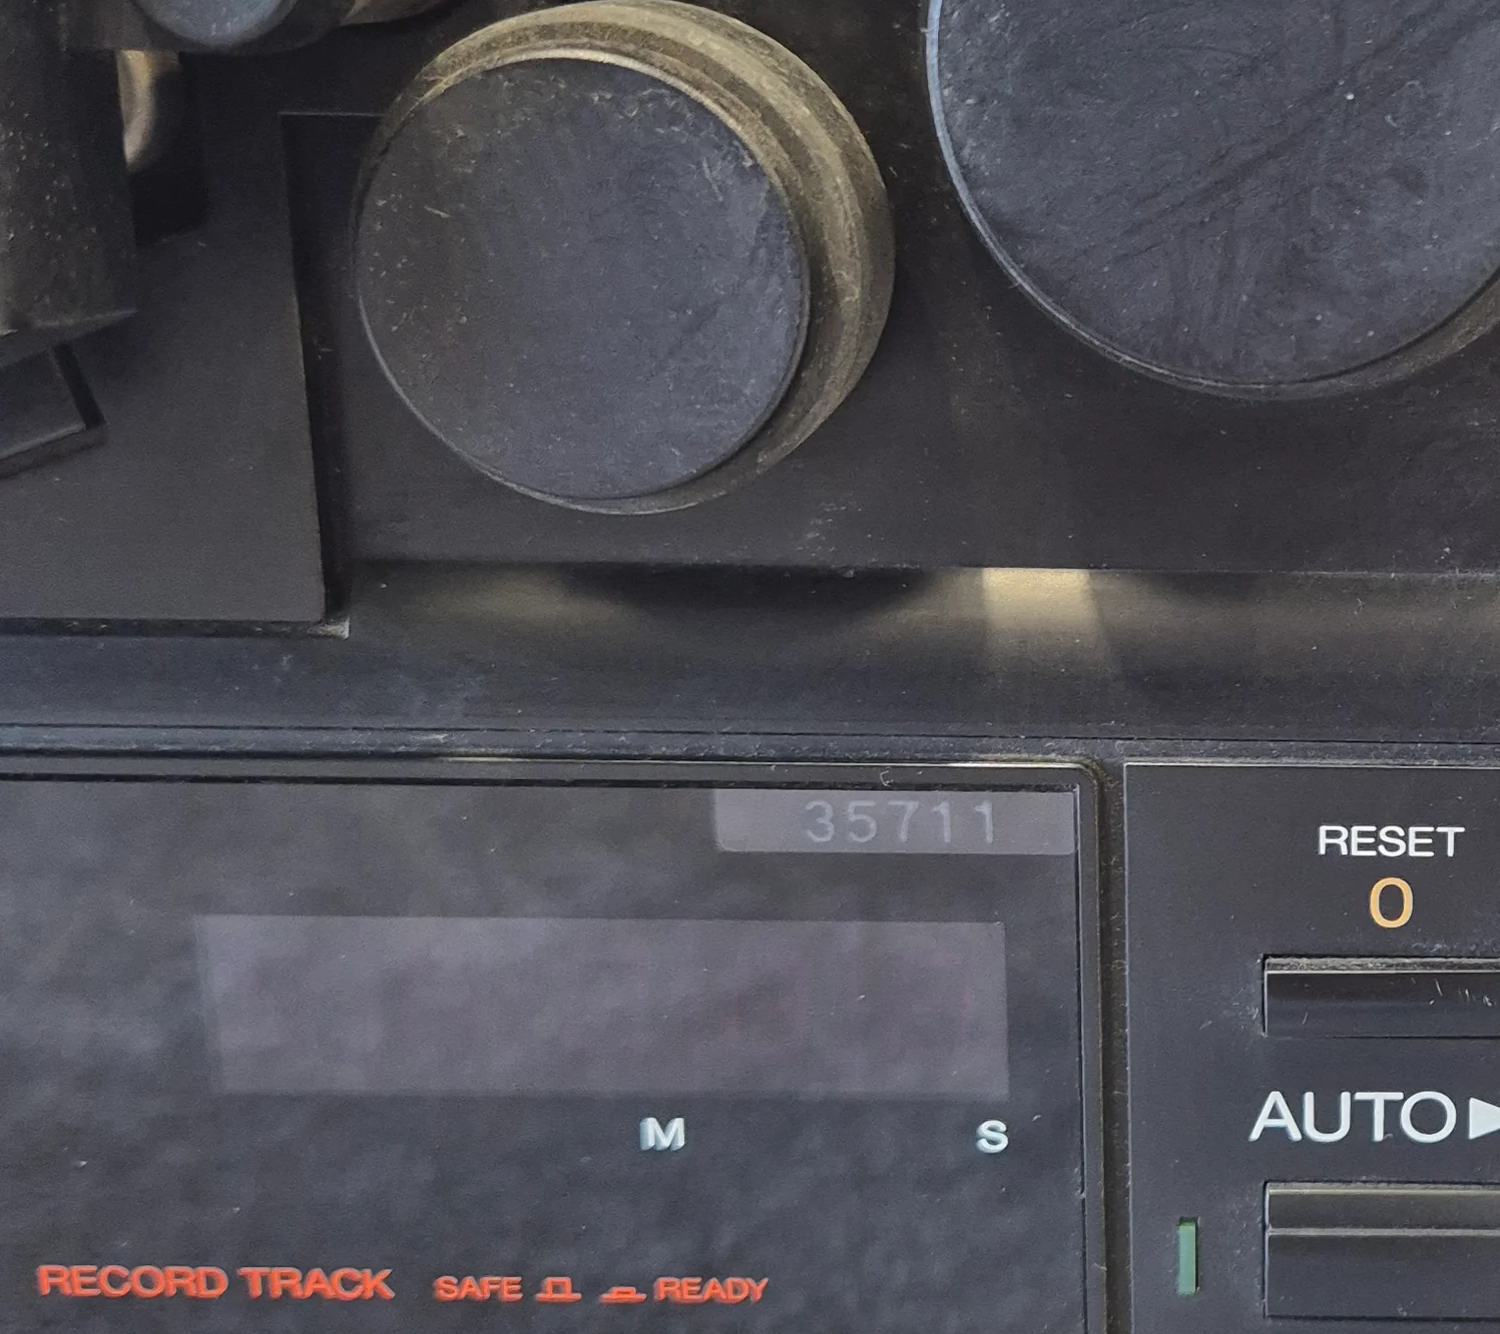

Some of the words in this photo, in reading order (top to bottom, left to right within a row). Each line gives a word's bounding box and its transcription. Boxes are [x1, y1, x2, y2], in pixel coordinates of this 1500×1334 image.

[805, 799, 995, 844] 35711
[1318, 824, 1466, 859] RESET
[638, 1116, 687, 1153] M
[1248, 1089, 1458, 1145] AUTO
[975, 1119, 1010, 1155] S
[36, 1264, 229, 1299] RECORD
[238, 1266, 396, 1302] TRACK
[433, 1274, 523, 1303] SAFE
[653, 1276, 770, 1304] READY
